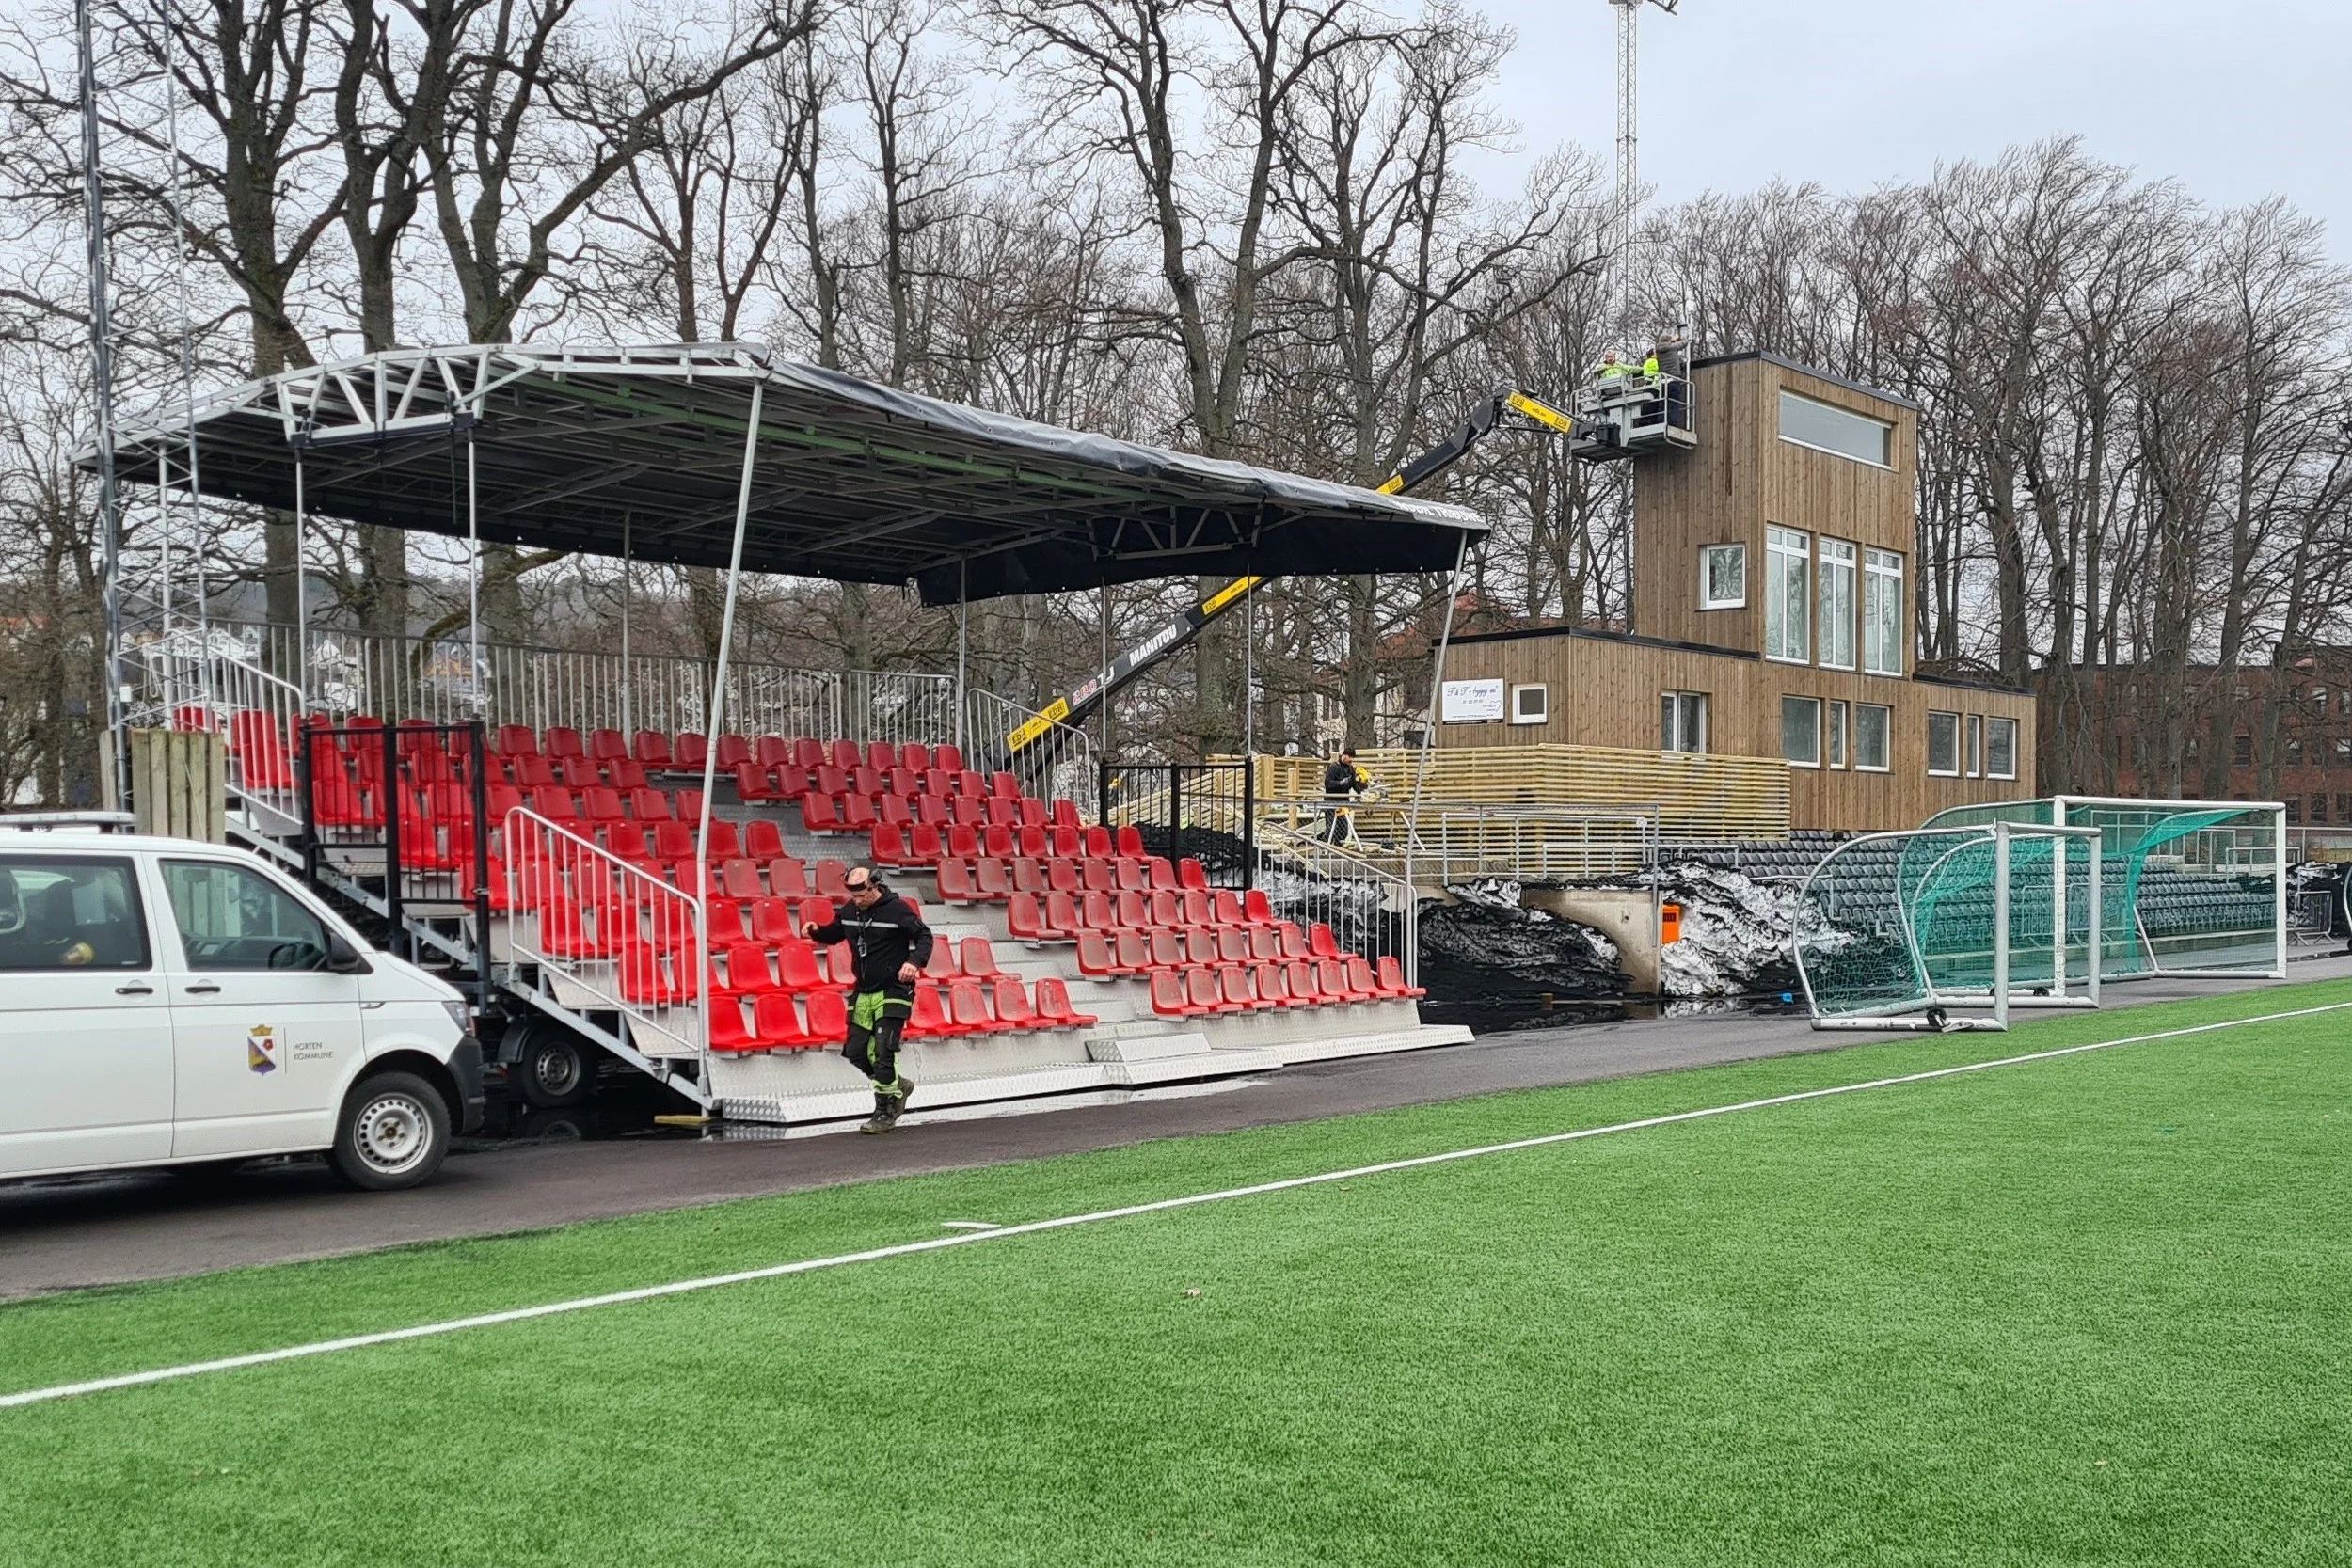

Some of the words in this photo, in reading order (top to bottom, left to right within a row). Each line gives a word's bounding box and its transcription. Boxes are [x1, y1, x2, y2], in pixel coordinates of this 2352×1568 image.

[1128, 624, 1177, 667] MANITOU
[293, 1042, 323, 1051] HORTEN
[293, 1051, 334, 1061] KOMMUNE
